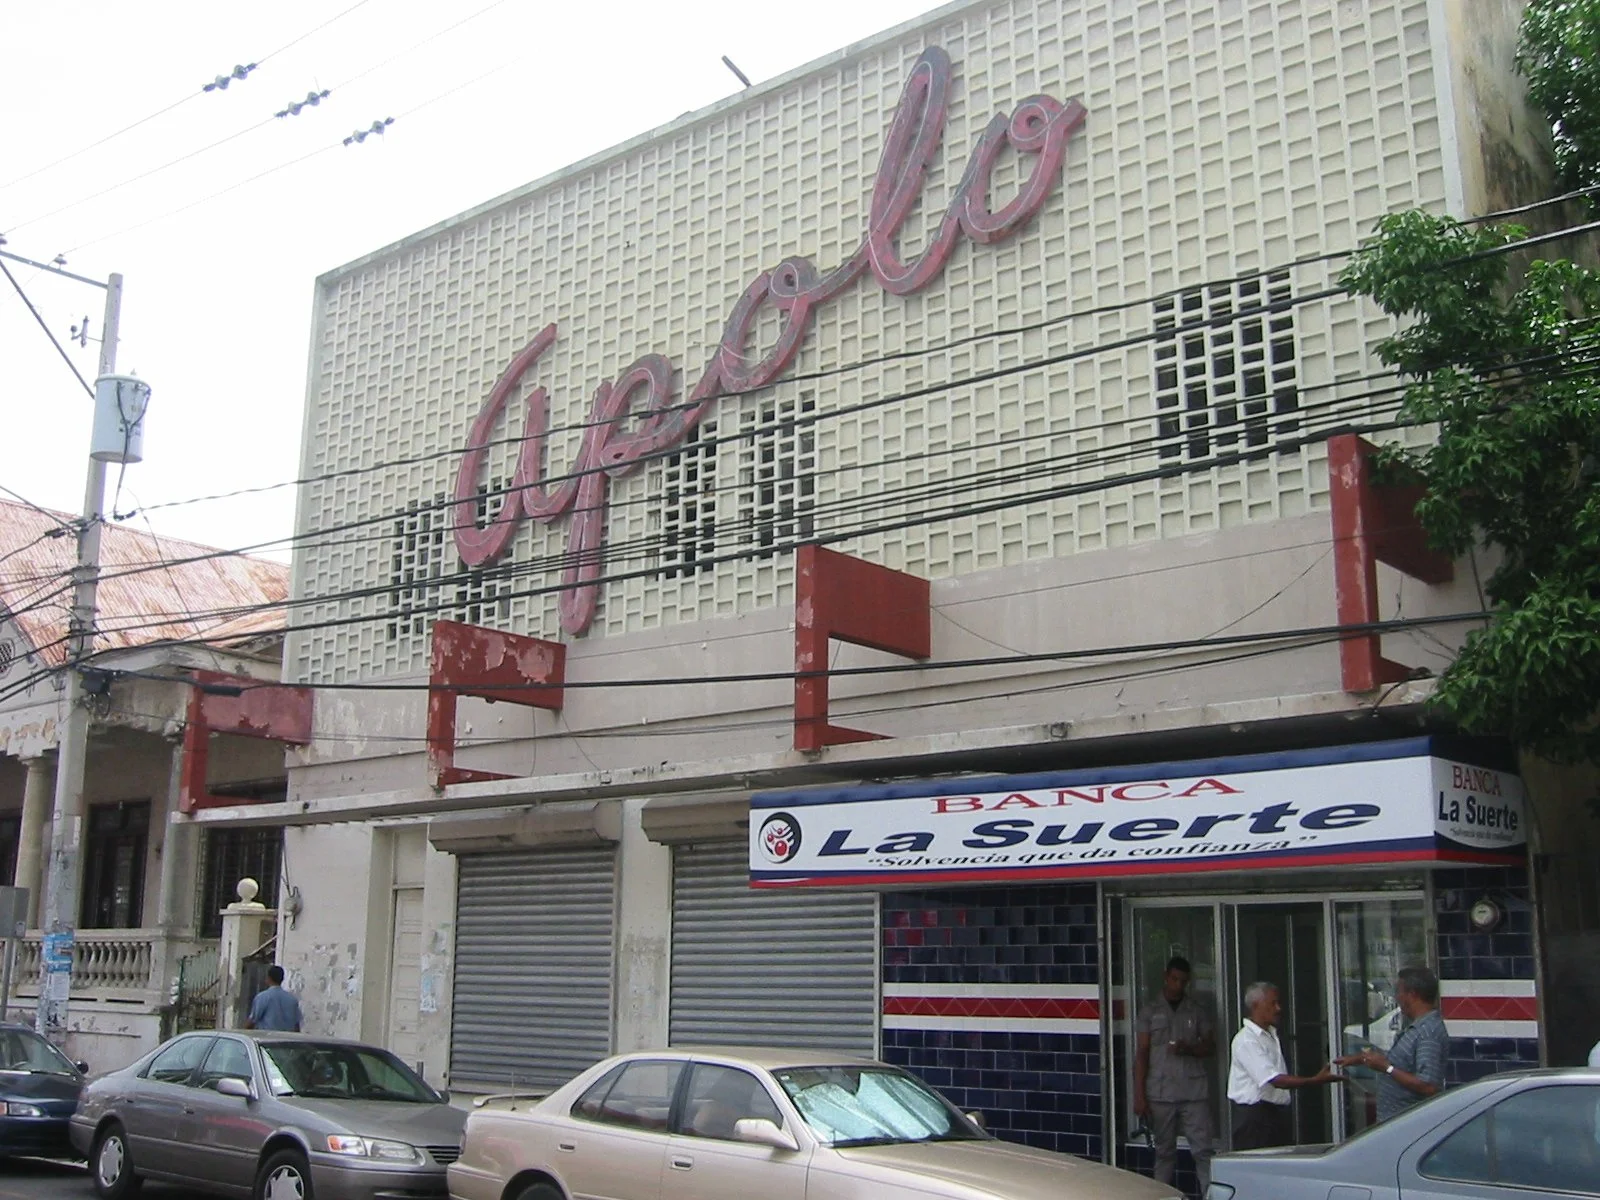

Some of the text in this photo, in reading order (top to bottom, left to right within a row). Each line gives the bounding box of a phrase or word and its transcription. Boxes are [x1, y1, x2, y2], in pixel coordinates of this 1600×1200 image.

[453, 45, 1087, 635] Apolo
[930, 778, 1244, 814] BANCA
[1452, 765, 1502, 797] BANCA
[817, 801, 1381, 857] La Suerte
[1438, 791, 1518, 830] La Suerte
[1018, 852, 1072, 864] que
[1079, 848, 1117, 858] da
